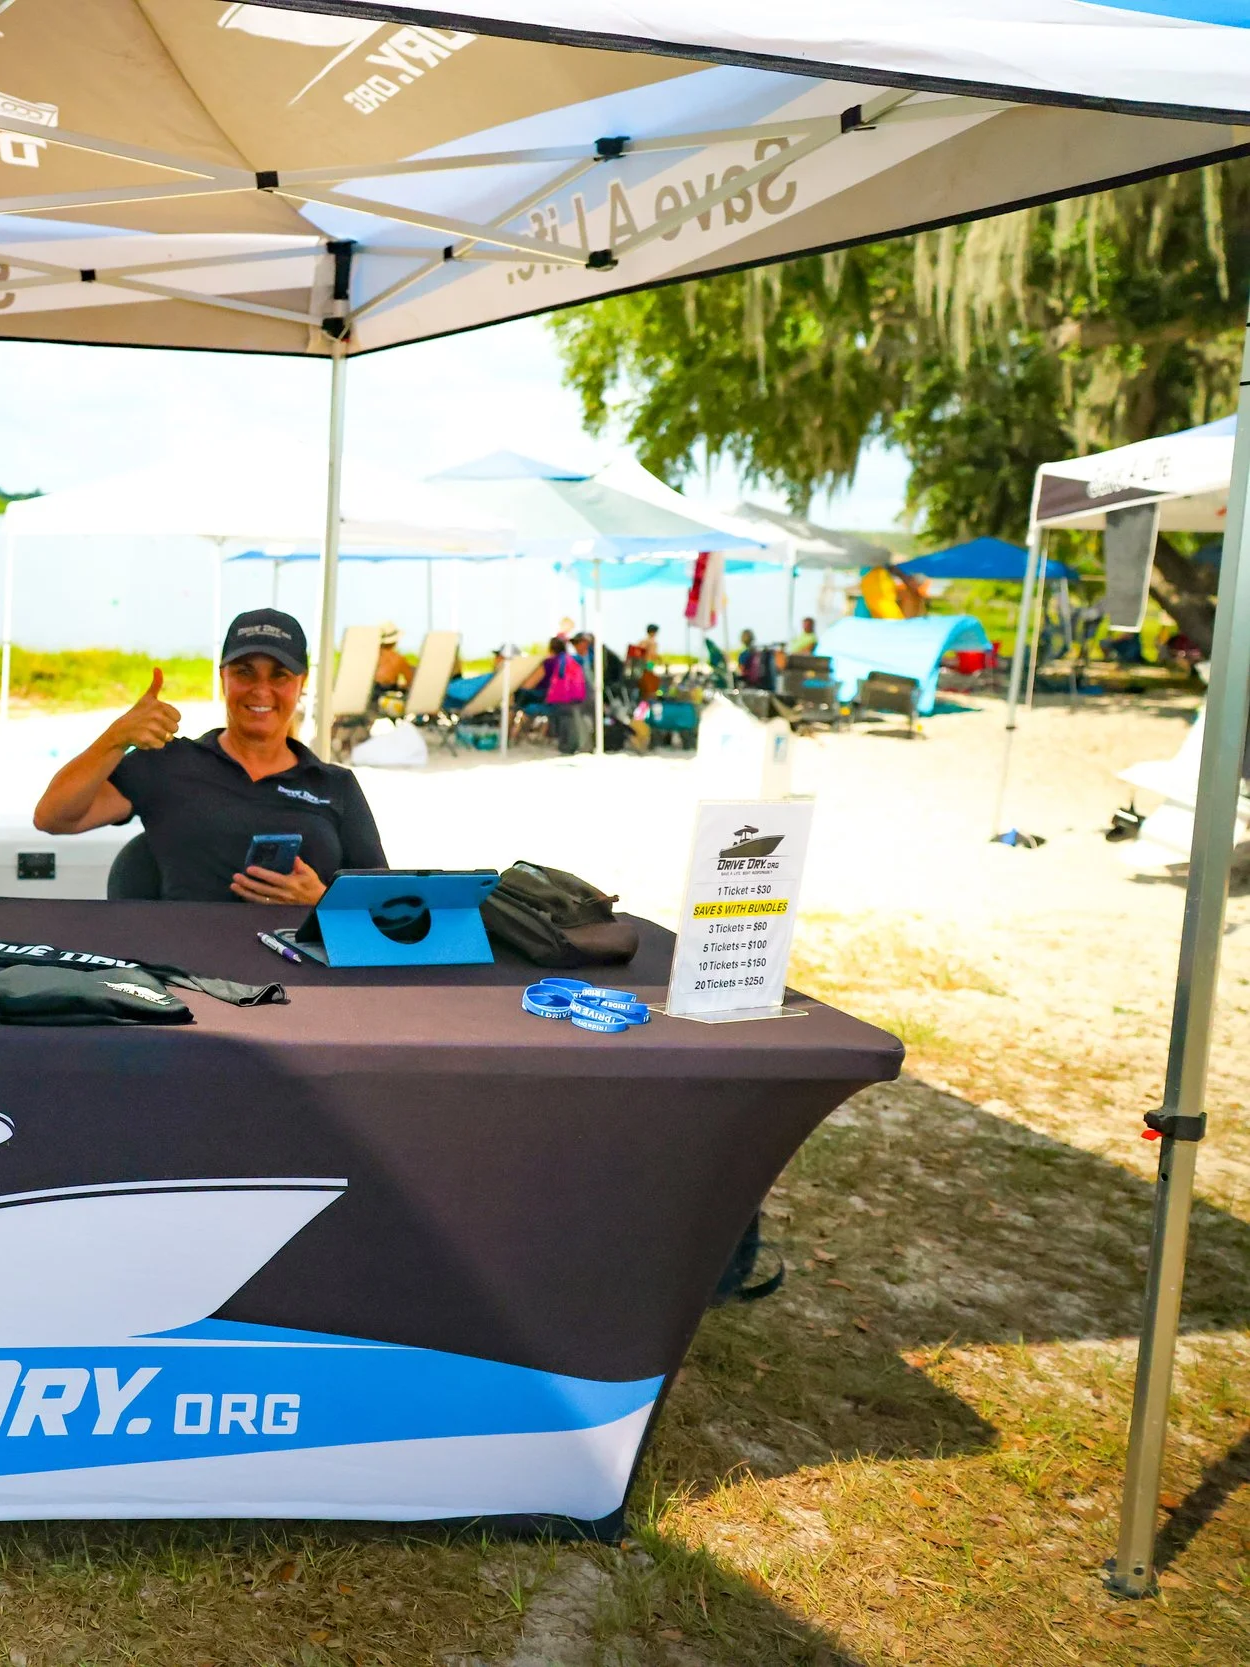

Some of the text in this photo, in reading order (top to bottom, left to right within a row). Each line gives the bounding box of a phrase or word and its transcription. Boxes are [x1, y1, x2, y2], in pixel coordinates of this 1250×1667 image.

[717, 859, 746, 870] DRIVE
[718, 887, 722, 896] 1
[724, 886, 748, 896] Ticket
[756, 884, 771, 894] $30
[693, 905, 716, 916] SAVE
[724, 904, 747, 914] WITH
[748, 902, 788, 913] BUNDLES
[709, 925, 714, 933] 3
[716, 924, 745, 933] Tickets
[753, 921, 767, 931] $60
[703, 944, 709, 952] 5
[710, 942, 740, 952] Tickets
[748, 940, 767, 950] $100
[698, 962, 707, 971] 10
[710, 961, 739, 971] Tickets
[747, 958, 766, 968] $150
[694, 980, 705, 990] 20
[707, 979, 736, 989] Tickets
[744, 976, 764, 986] $250
